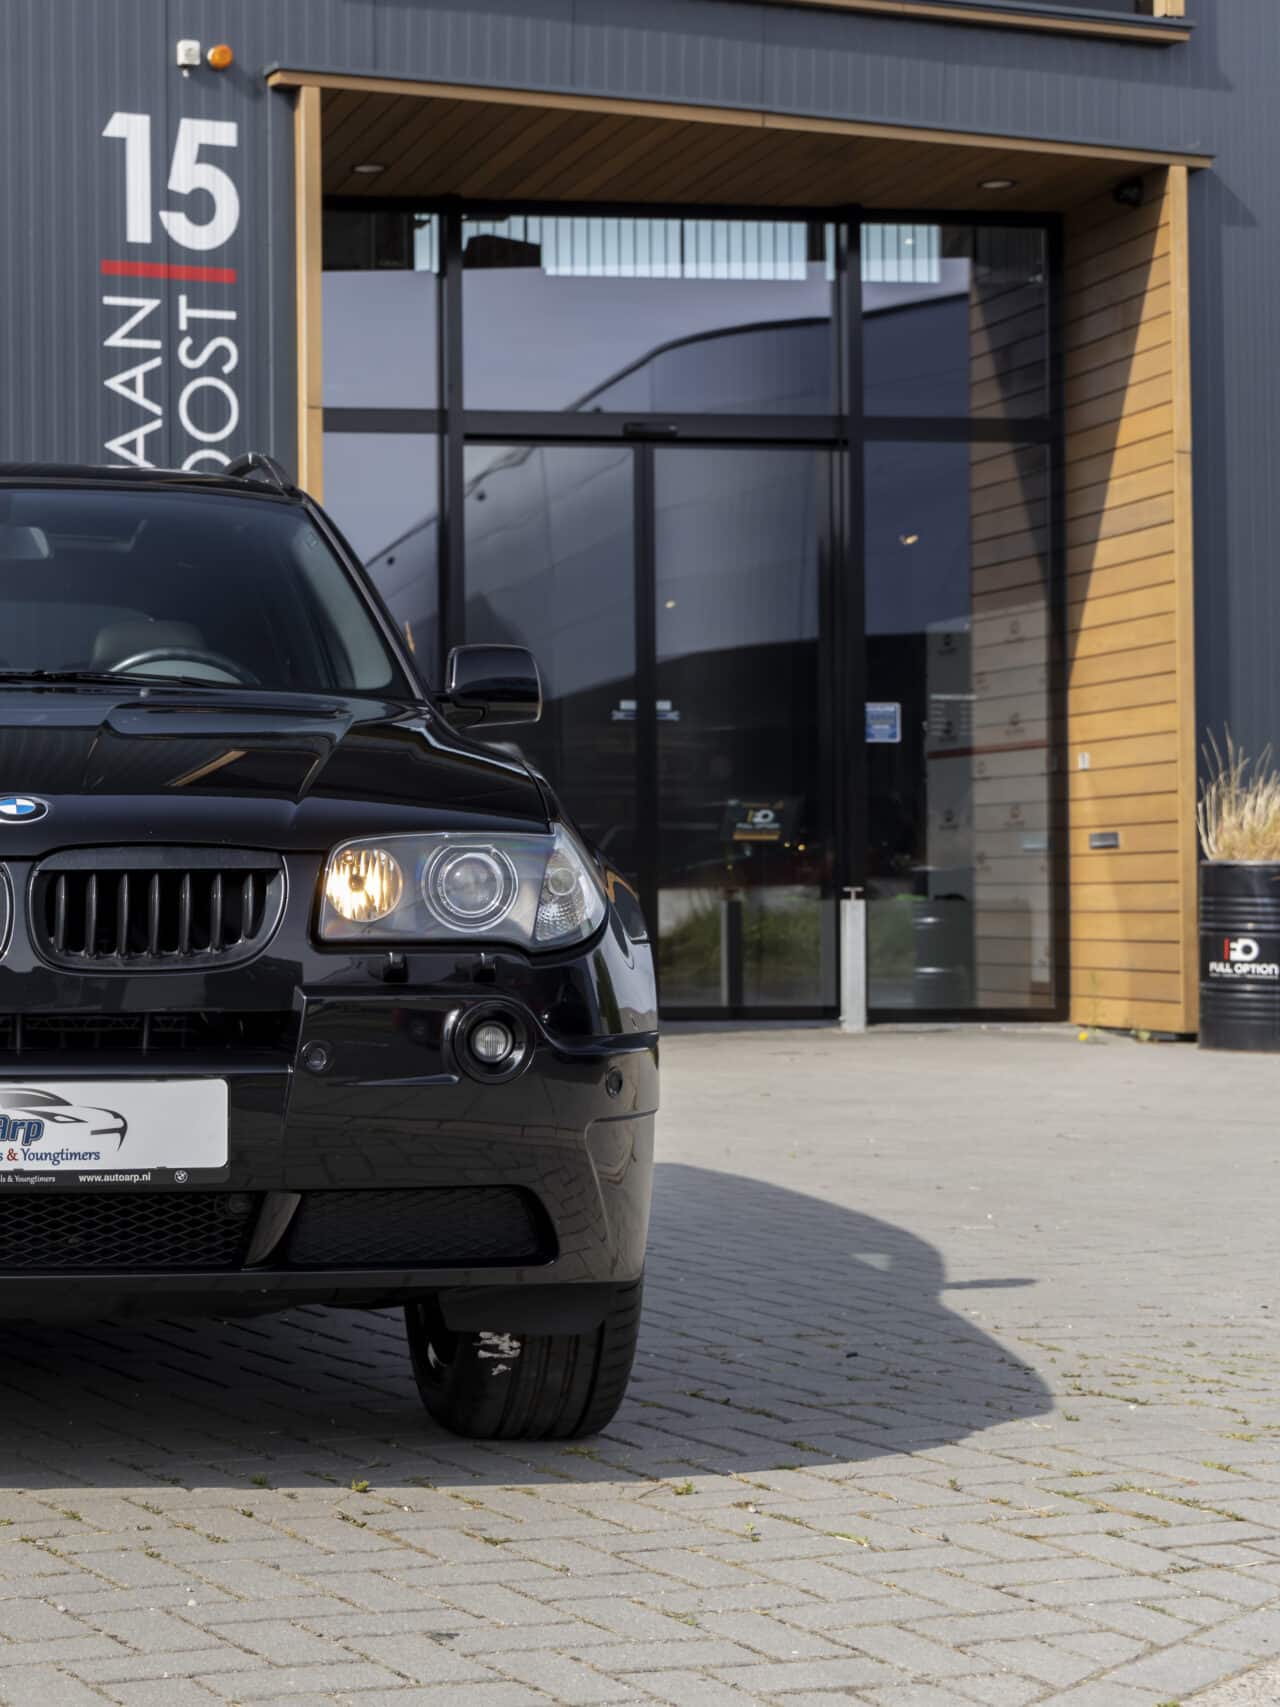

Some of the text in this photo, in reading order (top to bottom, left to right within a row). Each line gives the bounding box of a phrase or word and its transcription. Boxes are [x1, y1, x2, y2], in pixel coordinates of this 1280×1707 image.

[102, 111, 240, 251] 15
[6, 1149, 19, 1162] &
[20, 1149, 101, 1166] Youngtimers
[78, 1172, 151, 1183] www.autoarp.nl
